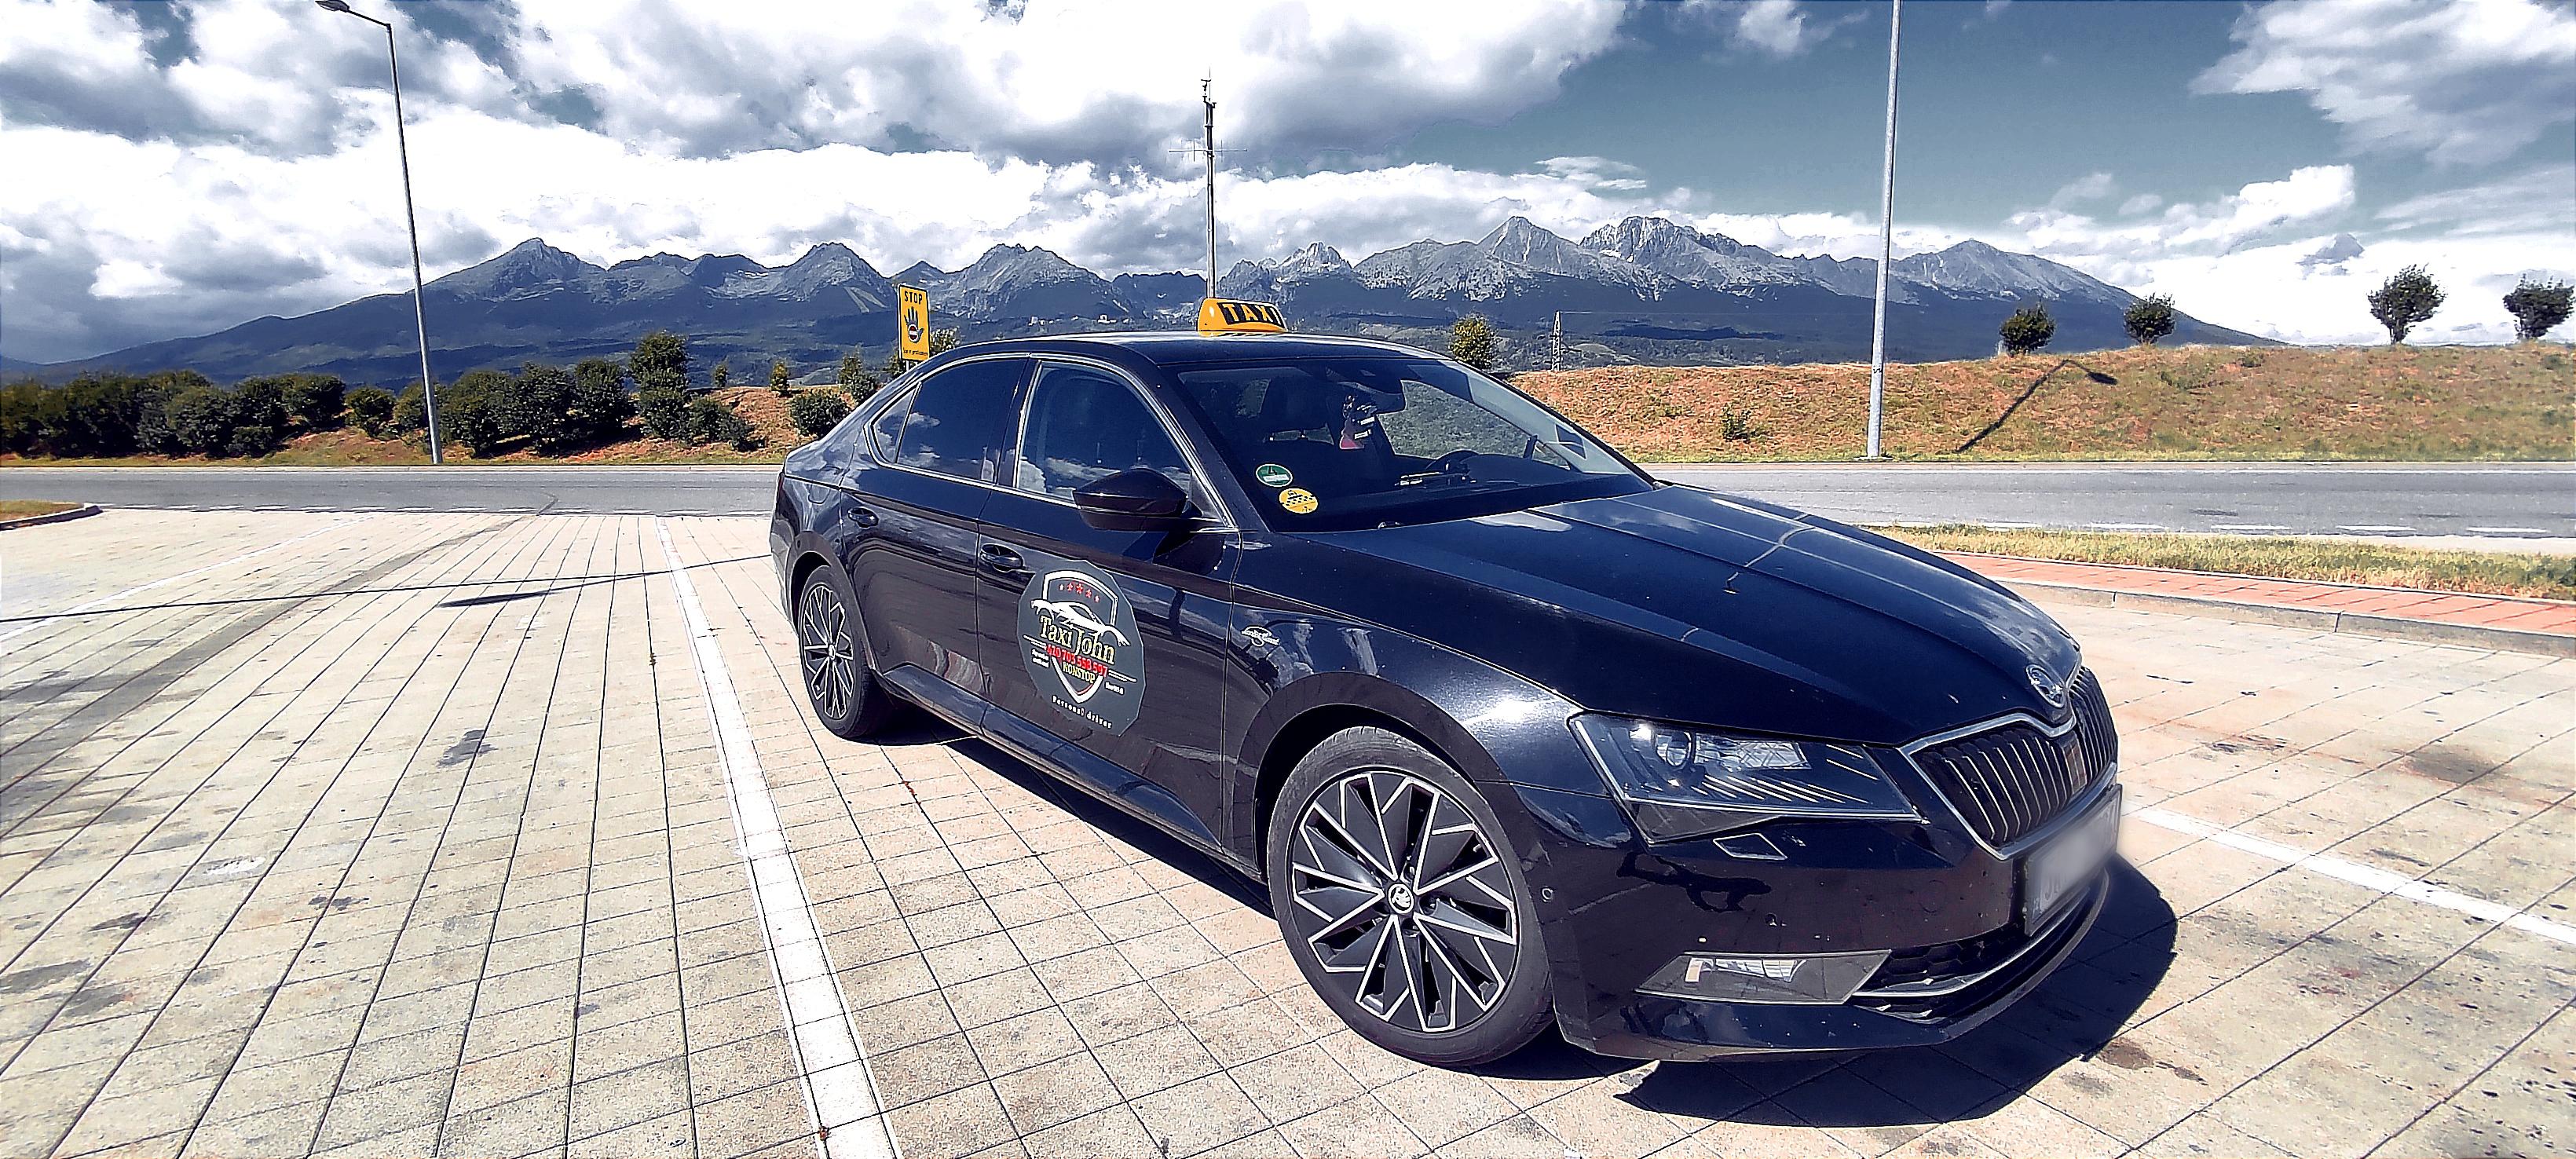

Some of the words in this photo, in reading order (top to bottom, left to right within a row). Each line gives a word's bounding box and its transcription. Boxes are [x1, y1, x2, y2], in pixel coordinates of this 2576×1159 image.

[905, 291, 923, 305] STOP
[1222, 303, 1282, 325] TAXI
[1040, 615, 1073, 648] Taxi
[1075, 628, 1114, 665] John
[1063, 662, 1096, 684] NONSTOP
